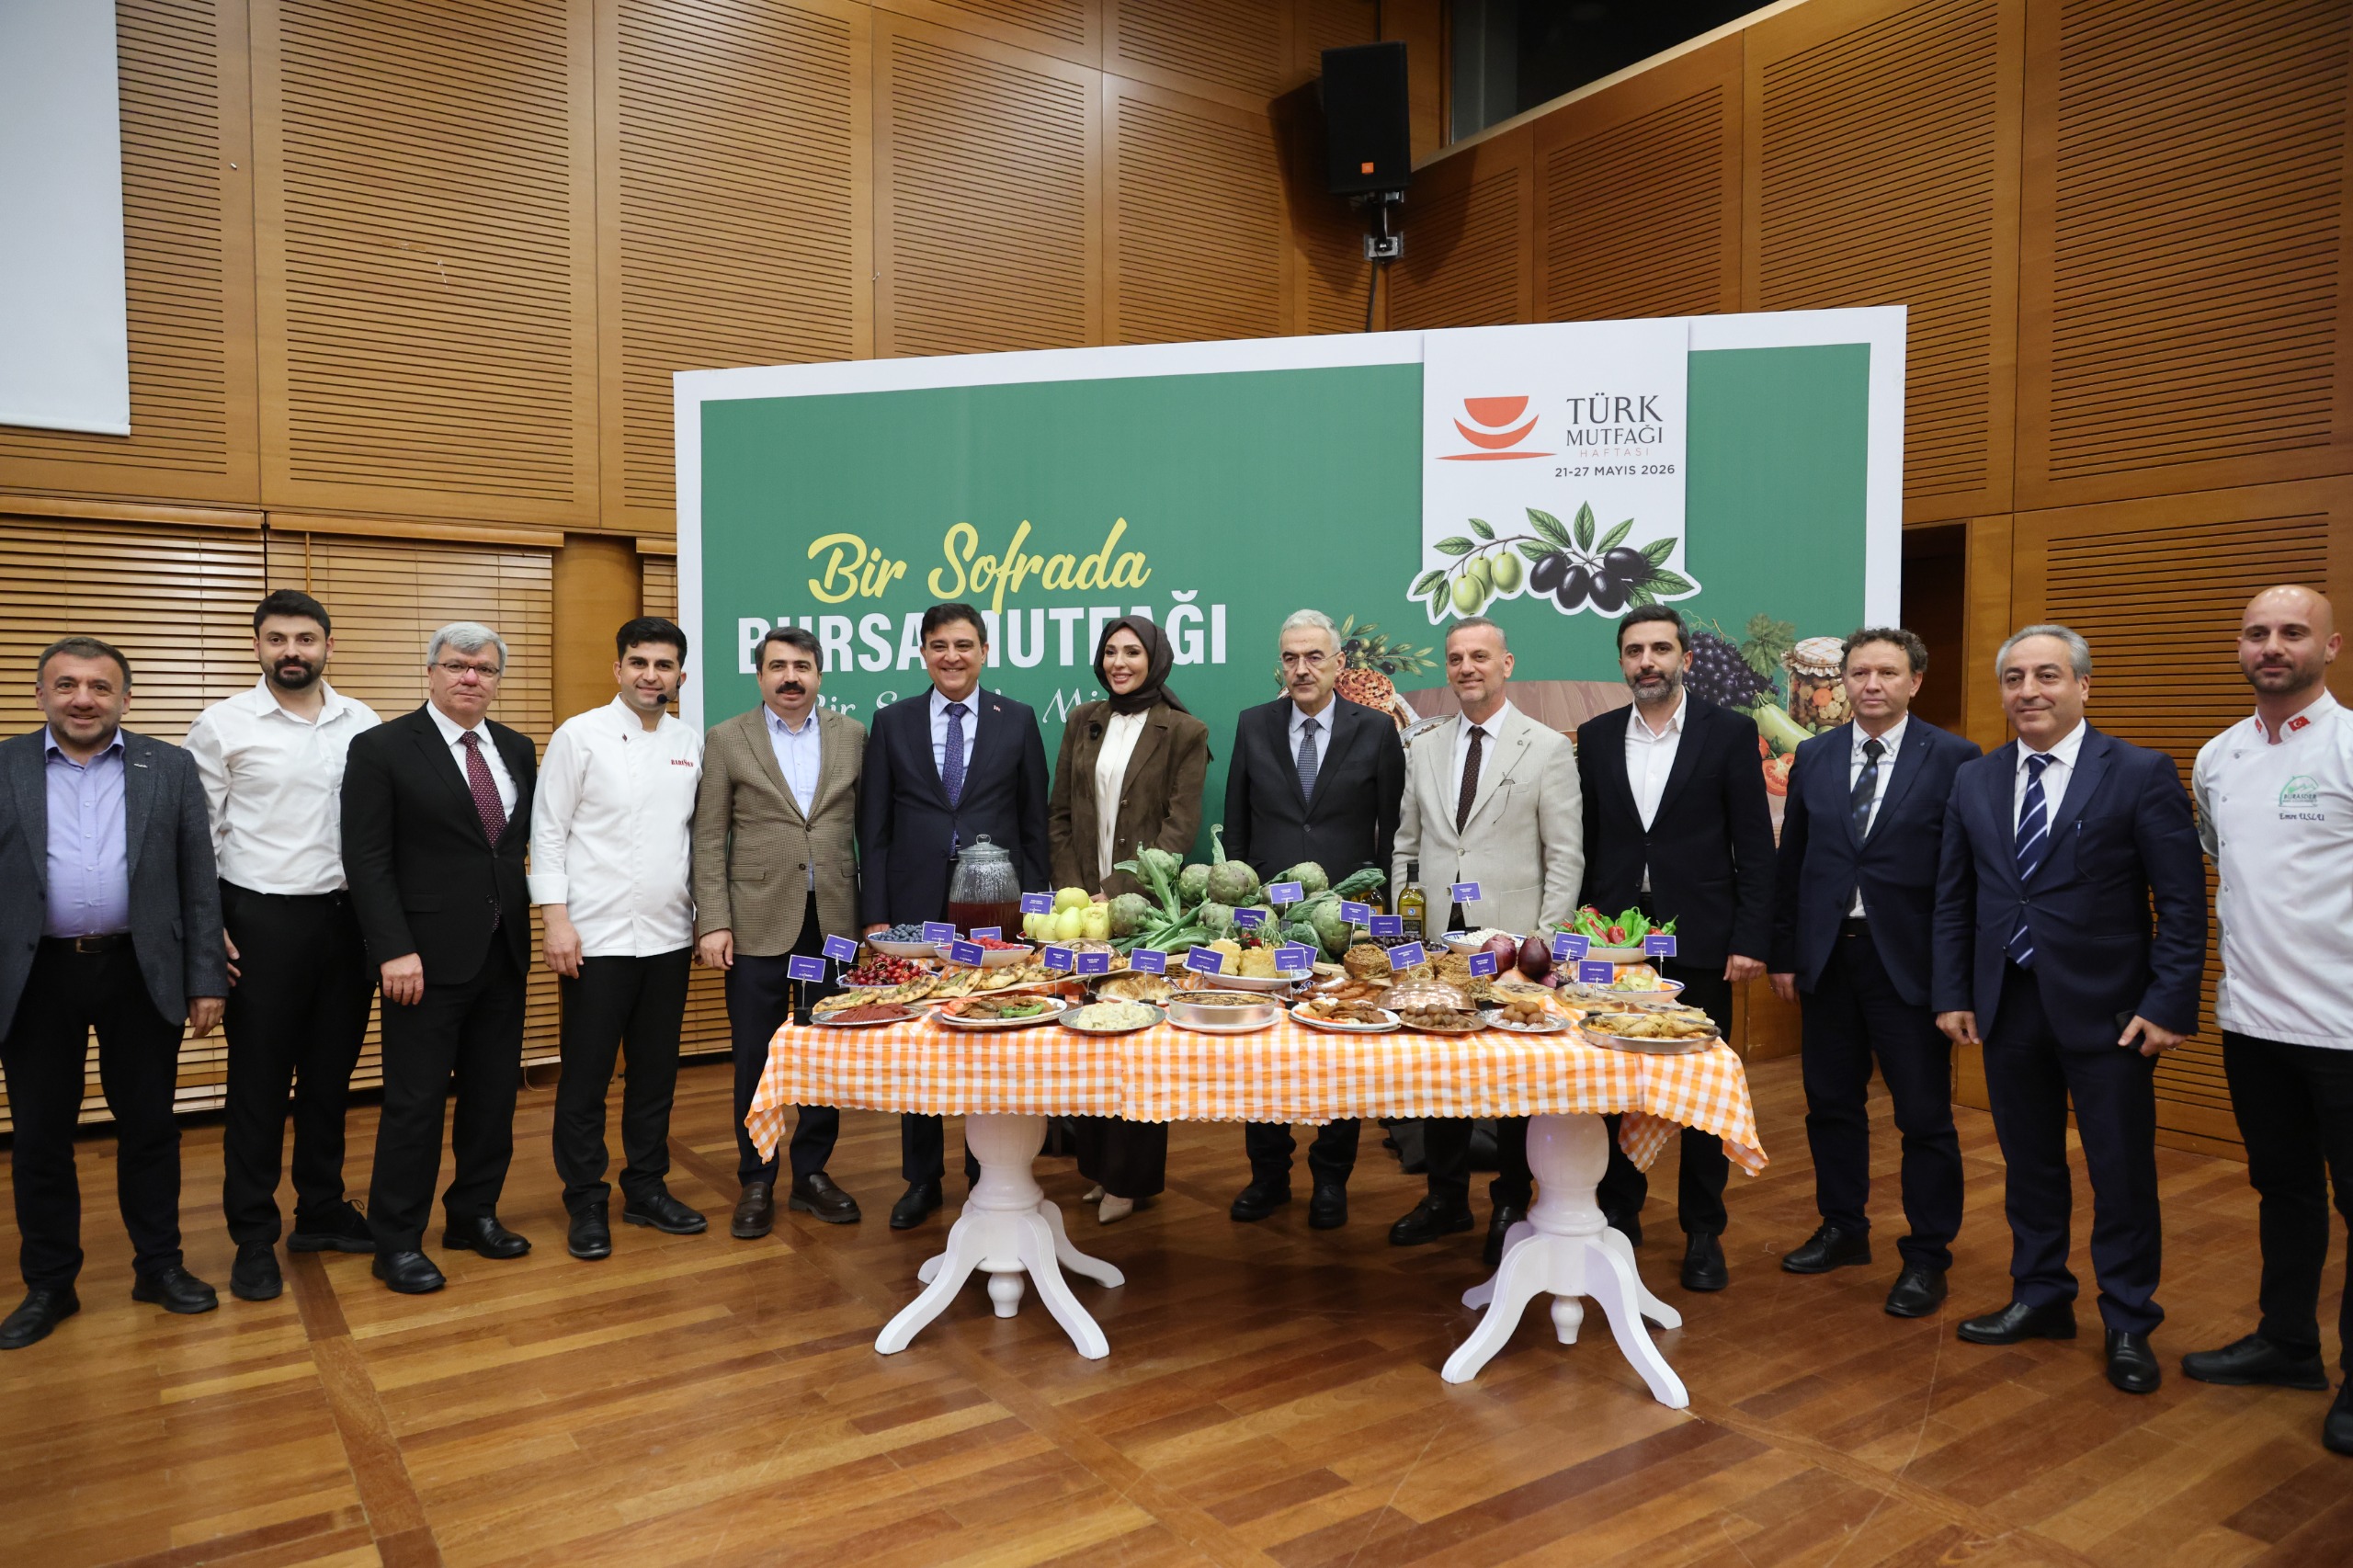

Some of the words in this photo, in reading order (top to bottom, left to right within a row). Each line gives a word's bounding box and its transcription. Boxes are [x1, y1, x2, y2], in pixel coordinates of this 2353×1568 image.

[1566, 392, 1664, 425] TÜRK
[1566, 425, 1663, 446] MUTFAĞI
[1580, 448, 1649, 458] HAFTASI
[1555, 467, 1589, 477] 21-27
[1595, 466, 1636, 476] MAYIS
[1642, 464, 1676, 475] 2026
[807, 532, 907, 604] Bir
[927, 517, 1152, 615] Sofrada
[738, 610, 926, 675] BRSA
[2299, 812, 2325, 821] USLU
